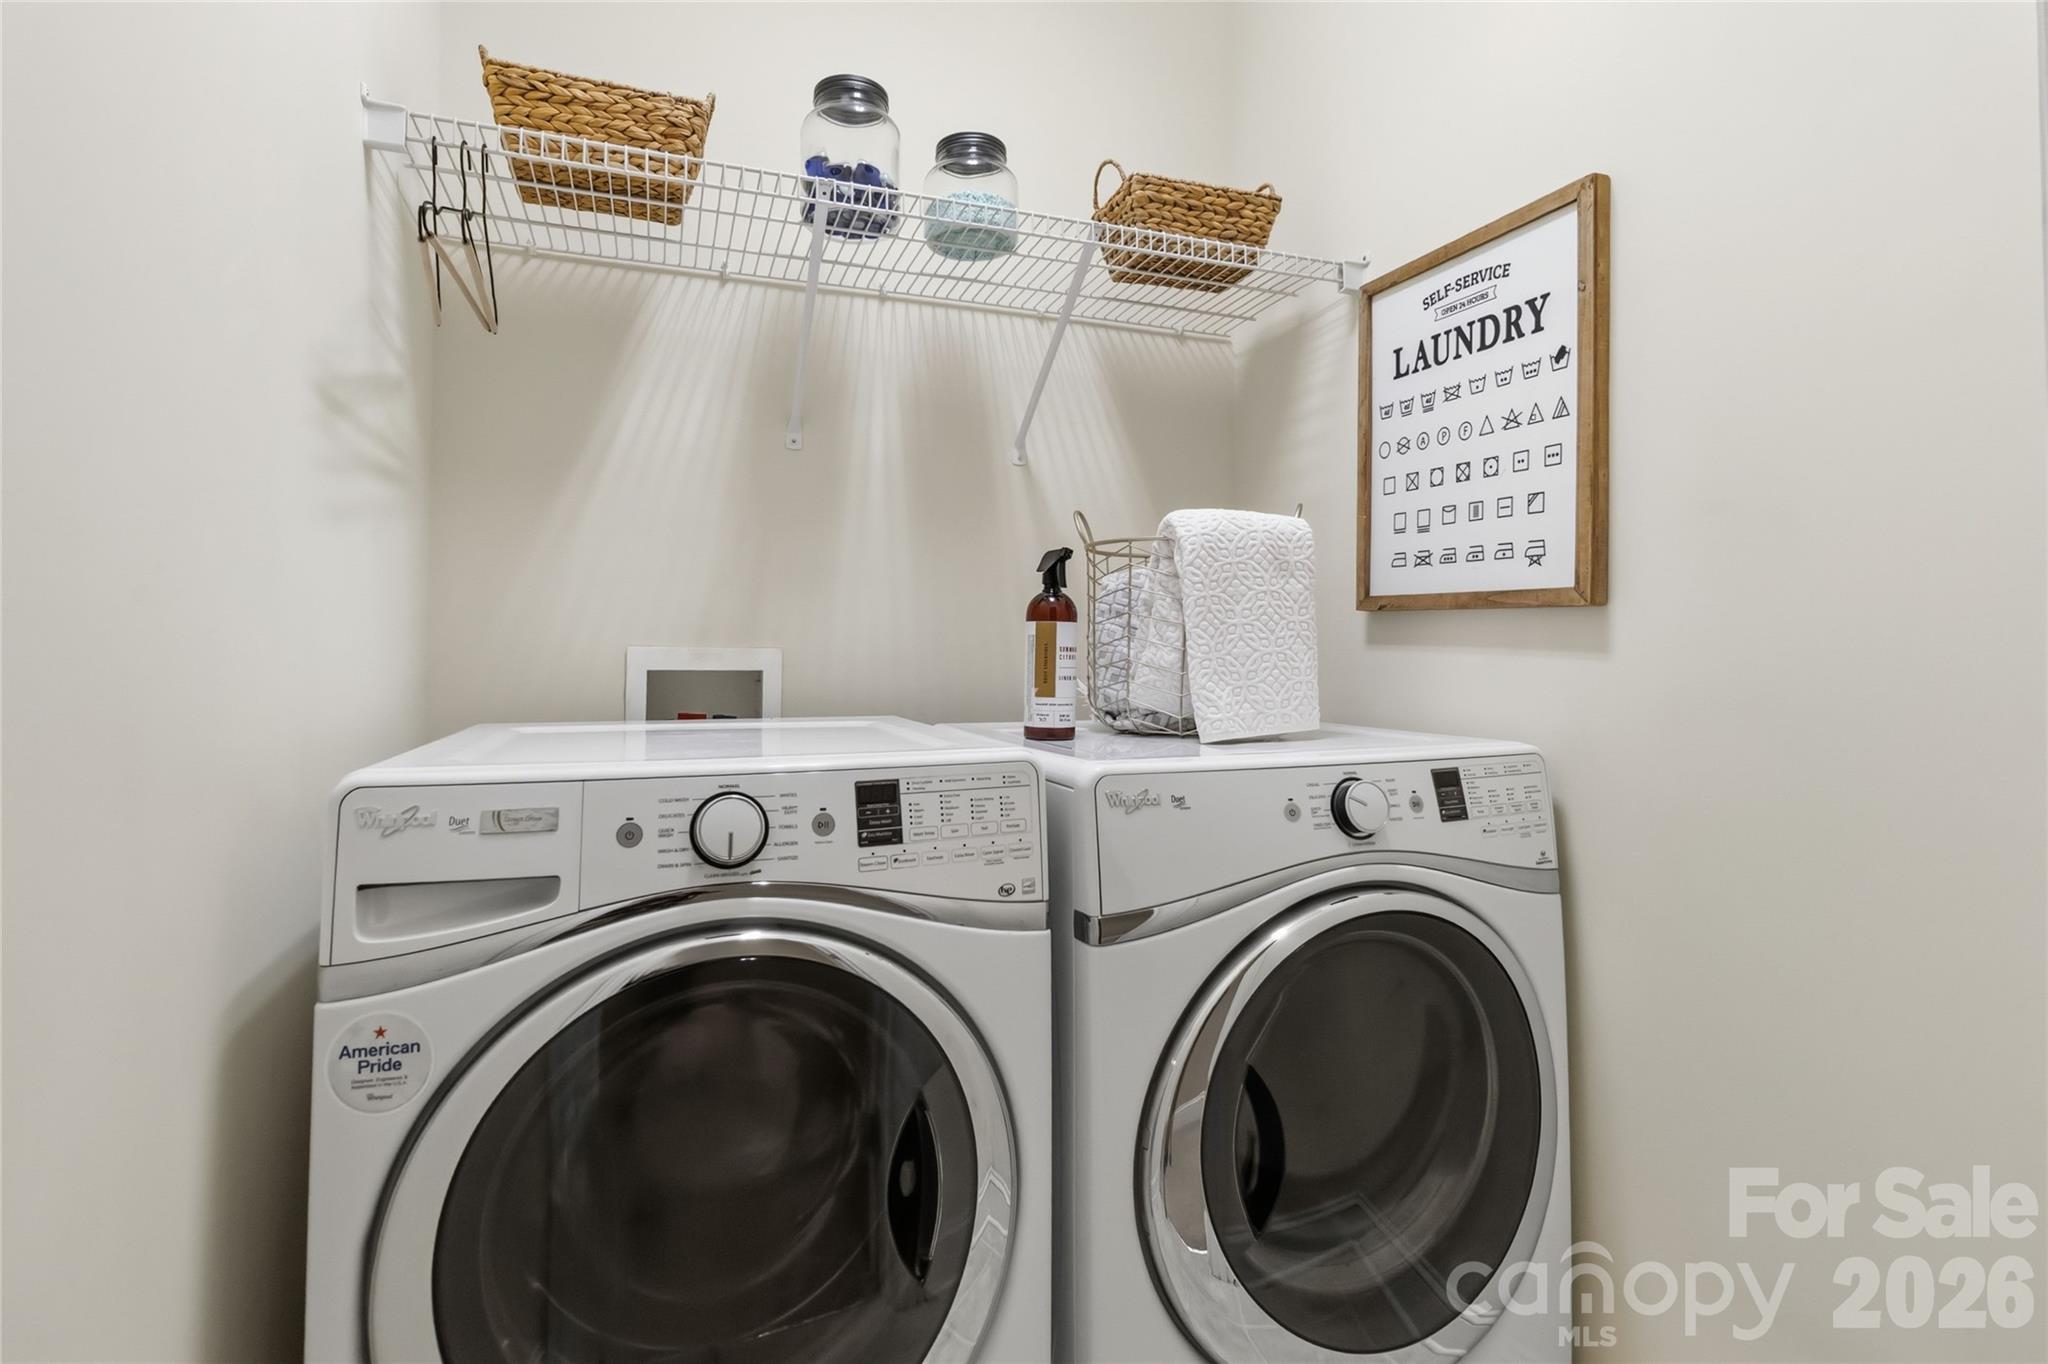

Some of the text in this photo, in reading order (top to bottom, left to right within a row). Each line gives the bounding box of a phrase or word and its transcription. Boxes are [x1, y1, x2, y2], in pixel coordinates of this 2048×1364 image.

[1422, 263, 1511, 311] SELF-SERVICE
[1440, 292, 1489, 316] OPEN 24 HOURS
[1393, 292, 1551, 380] LAUNDRY
[448, 815, 470, 828] Duet
[338, 1041, 421, 1061] American
[357, 1058, 402, 1075] Pride
